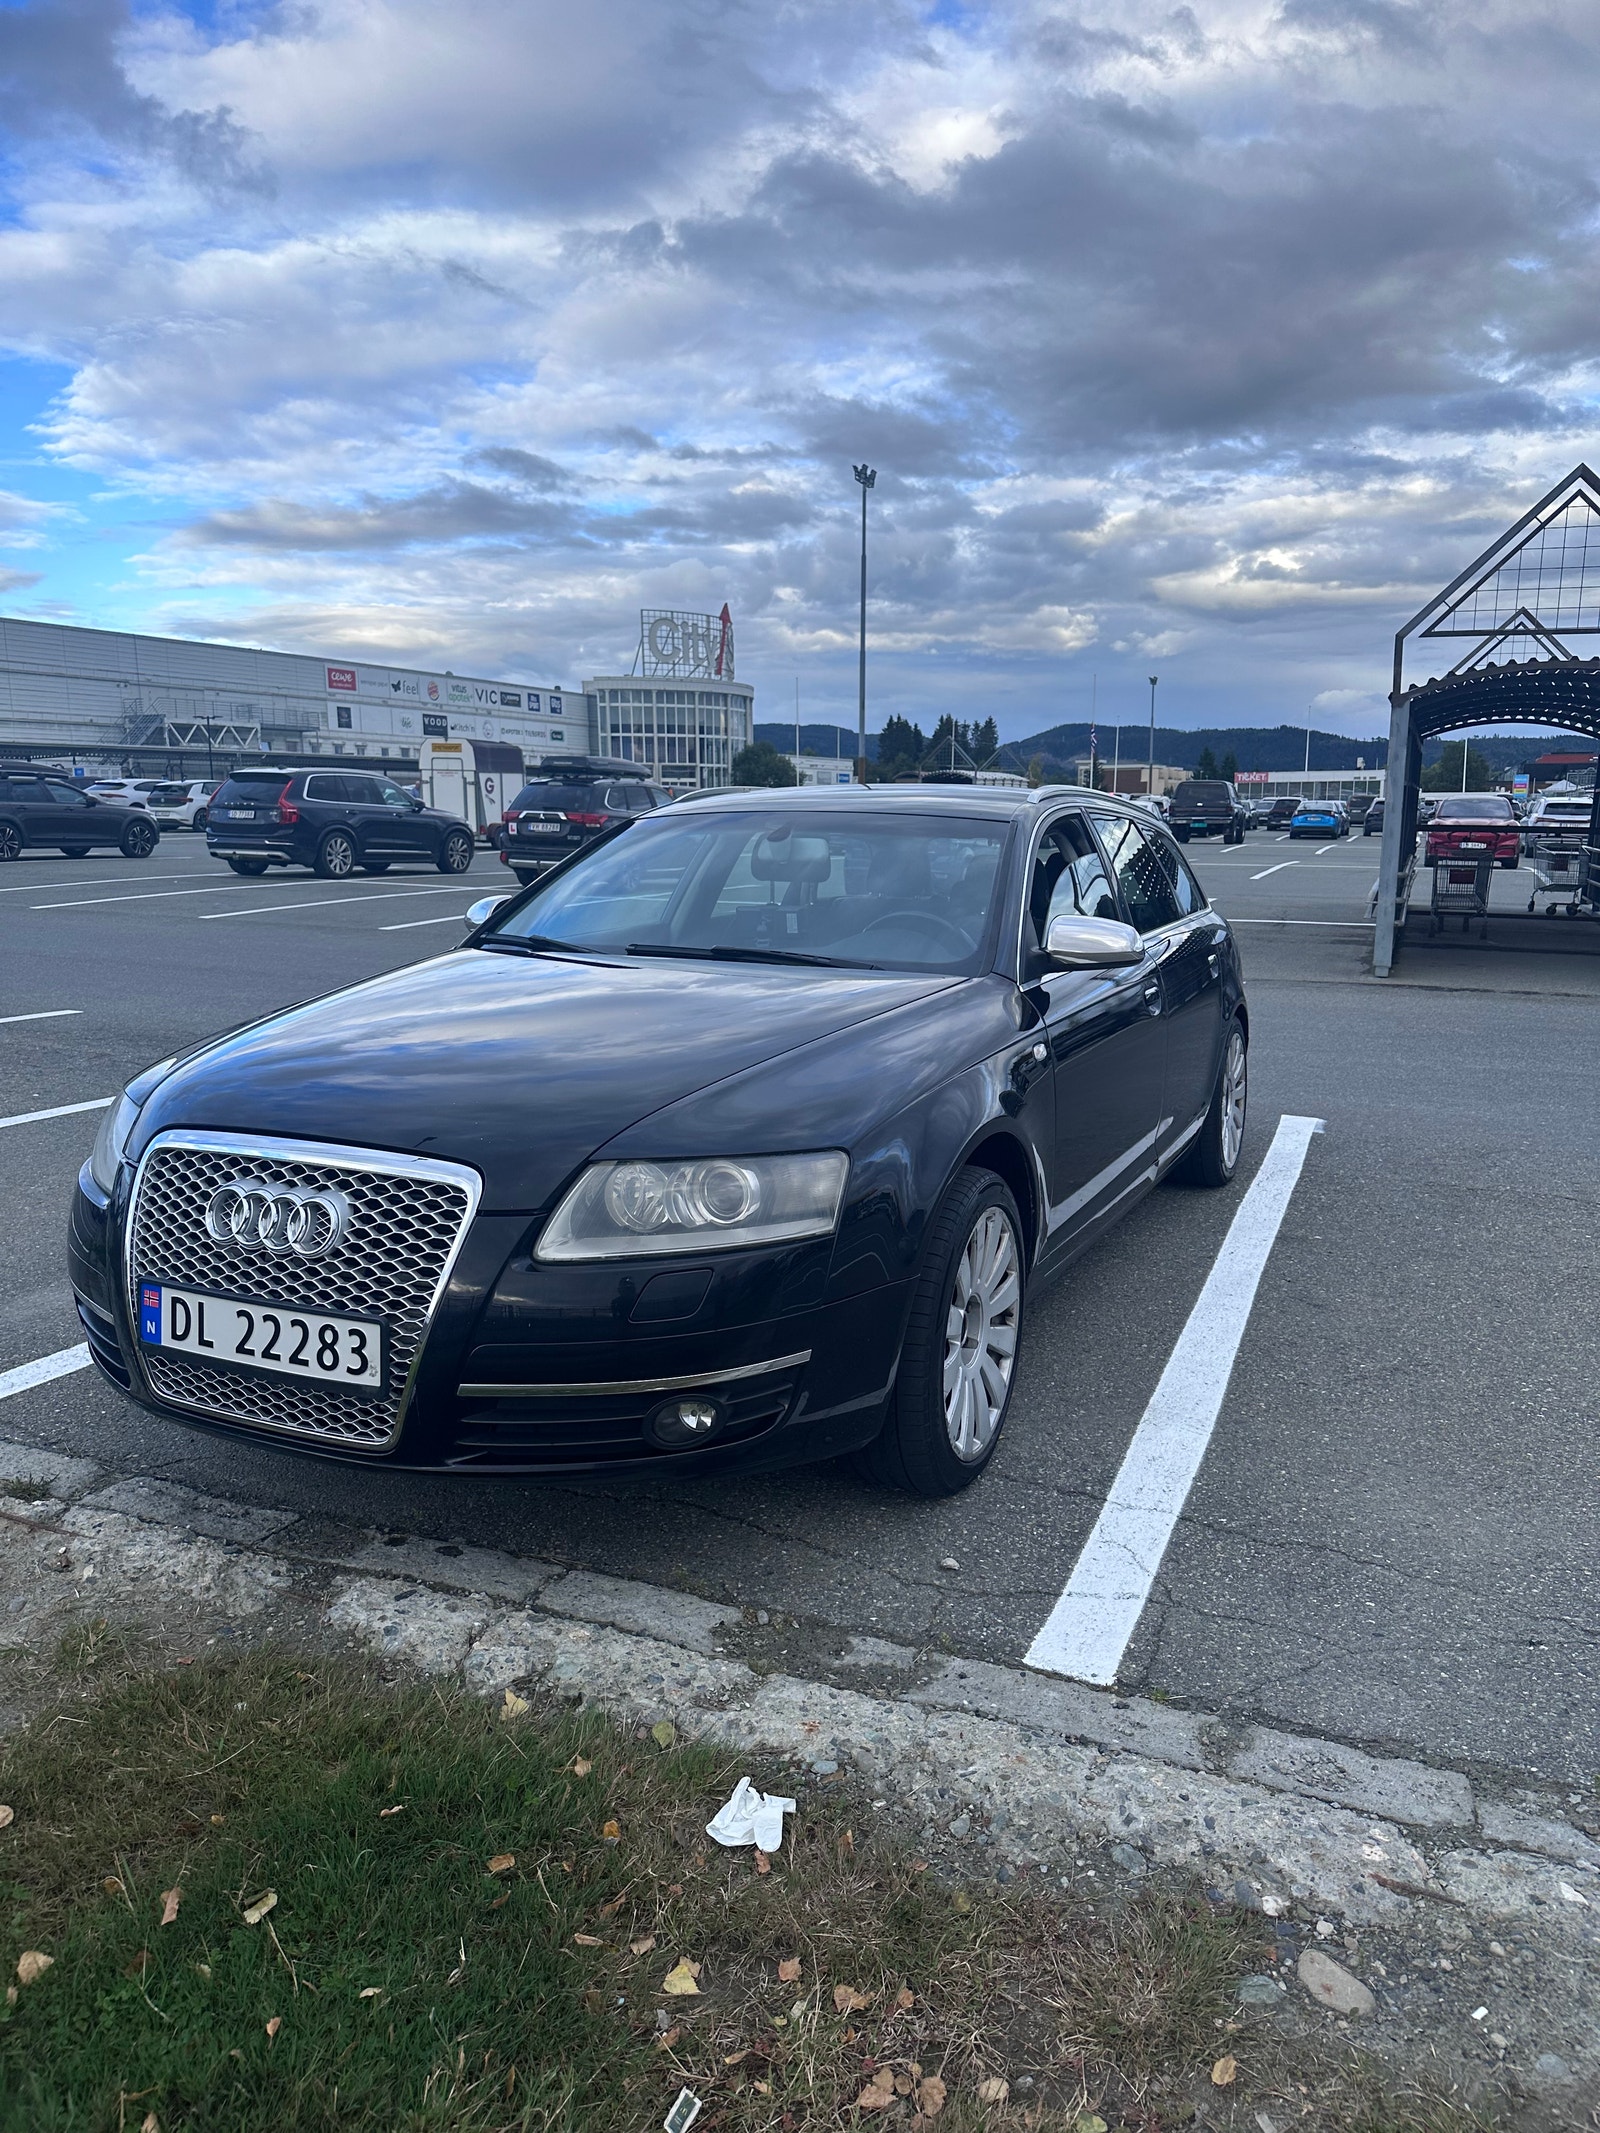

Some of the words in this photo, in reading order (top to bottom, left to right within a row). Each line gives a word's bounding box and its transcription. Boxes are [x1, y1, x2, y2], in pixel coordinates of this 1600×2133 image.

[648, 617, 719, 672] City
[331, 671, 353, 682] cewe
[402, 680, 419, 695] feel
[451, 684, 467, 694] vitus
[475, 687, 498, 705] VIC
[1237, 772, 1267, 781] TICKET
[484, 777, 495, 795] G
[146, 1320, 156, 1335] N
[170, 1296, 214, 1349] DL
[235, 1309, 369, 1375] 22283
